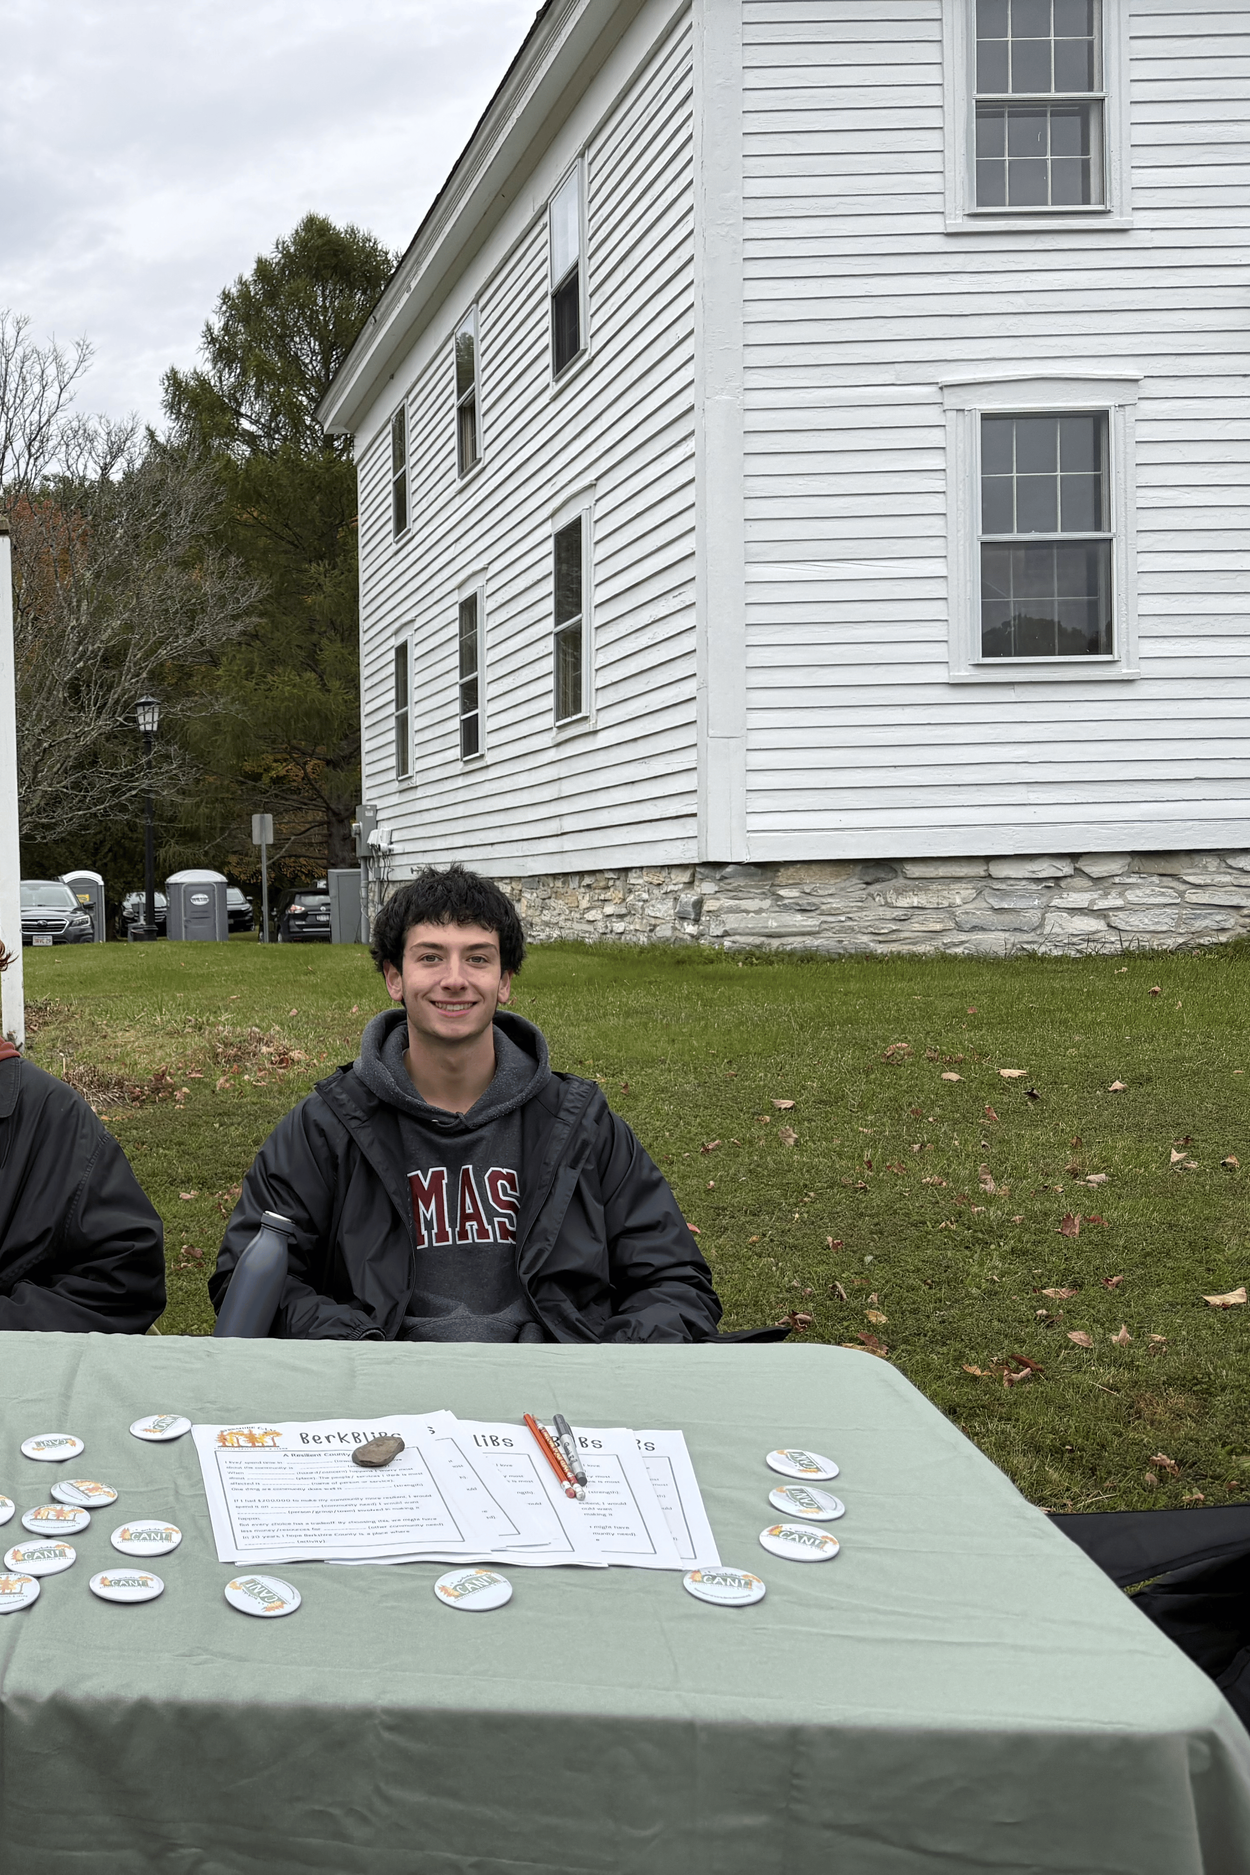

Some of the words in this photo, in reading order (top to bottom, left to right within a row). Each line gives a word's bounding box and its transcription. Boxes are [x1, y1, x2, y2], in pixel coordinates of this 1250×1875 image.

[131, 1532, 166, 1540] CAN!
[779, 1531, 821, 1547] CAN!
[24, 1549, 58, 1560] CAN!
[456, 1575, 491, 1594] CAN!
[703, 1575, 745, 1588] CAN!
